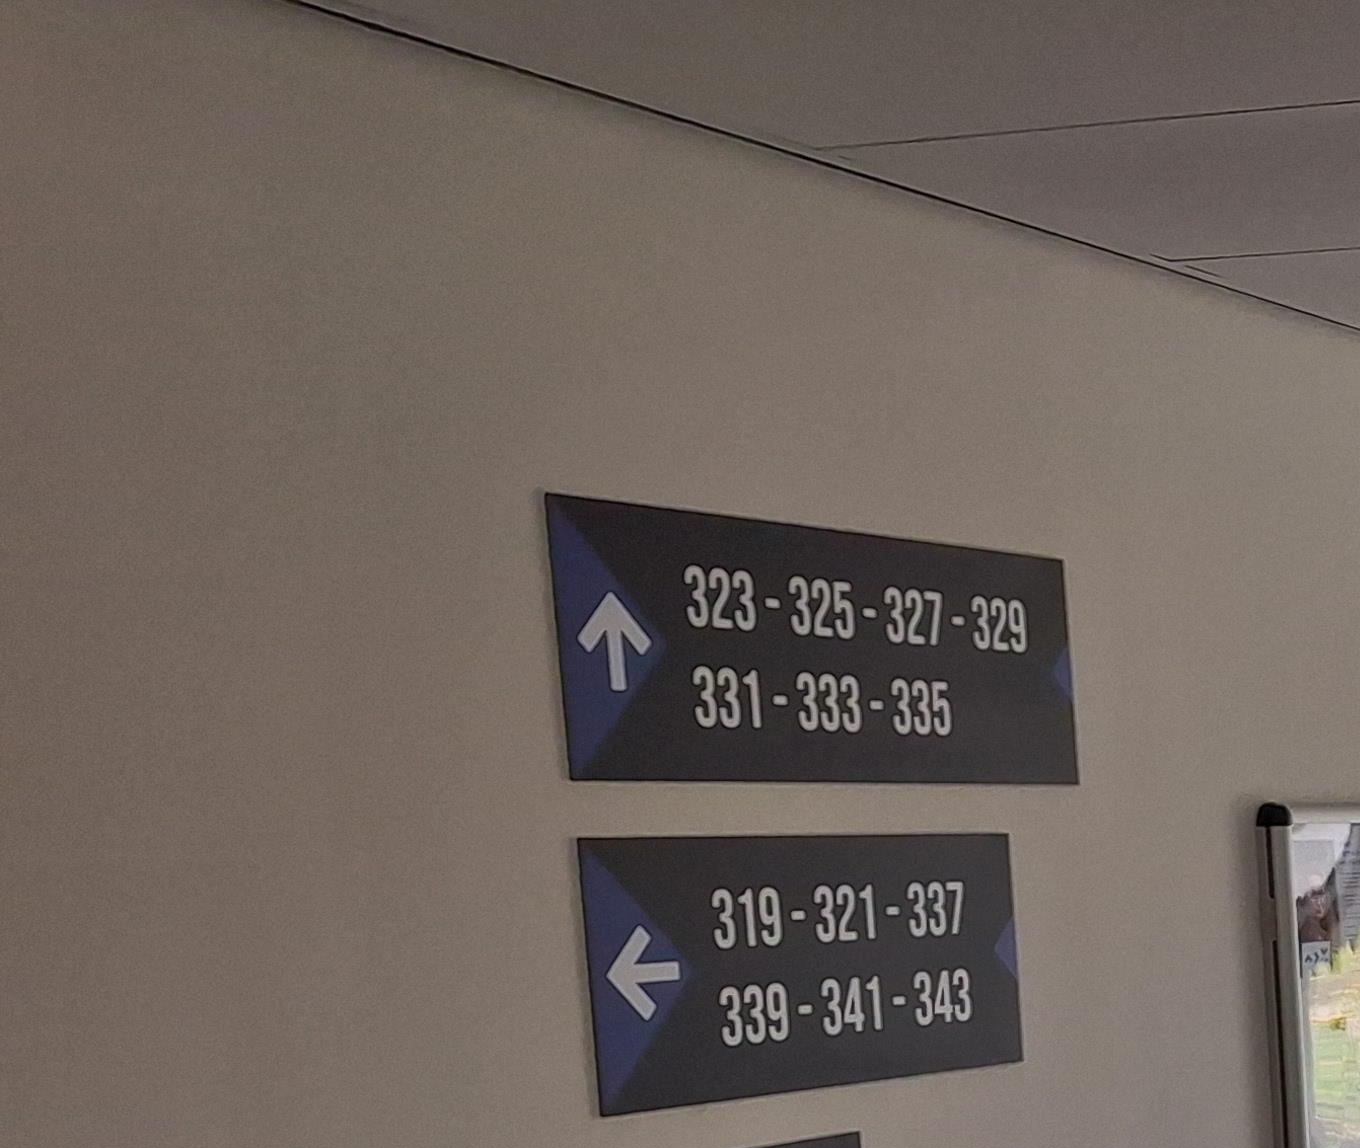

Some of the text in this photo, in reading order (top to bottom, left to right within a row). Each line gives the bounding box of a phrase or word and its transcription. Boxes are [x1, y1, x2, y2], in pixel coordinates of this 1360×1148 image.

[684, 565, 756, 631] 323
[789, 576, 854, 639] 325
[884, 587, 942, 646] 327
[971, 596, 1026, 653] 329
[693, 666, 762, 728] 331
[796, 672, 861, 733] 333
[891, 678, 951, 736] 335
[712, 887, 782, 949] 319
[814, 884, 876, 943] 321
[907, 881, 964, 937] 337
[719, 982, 789, 1046] 339
[821, 975, 882, 1036] 341
[913, 968, 972, 1026] 343
